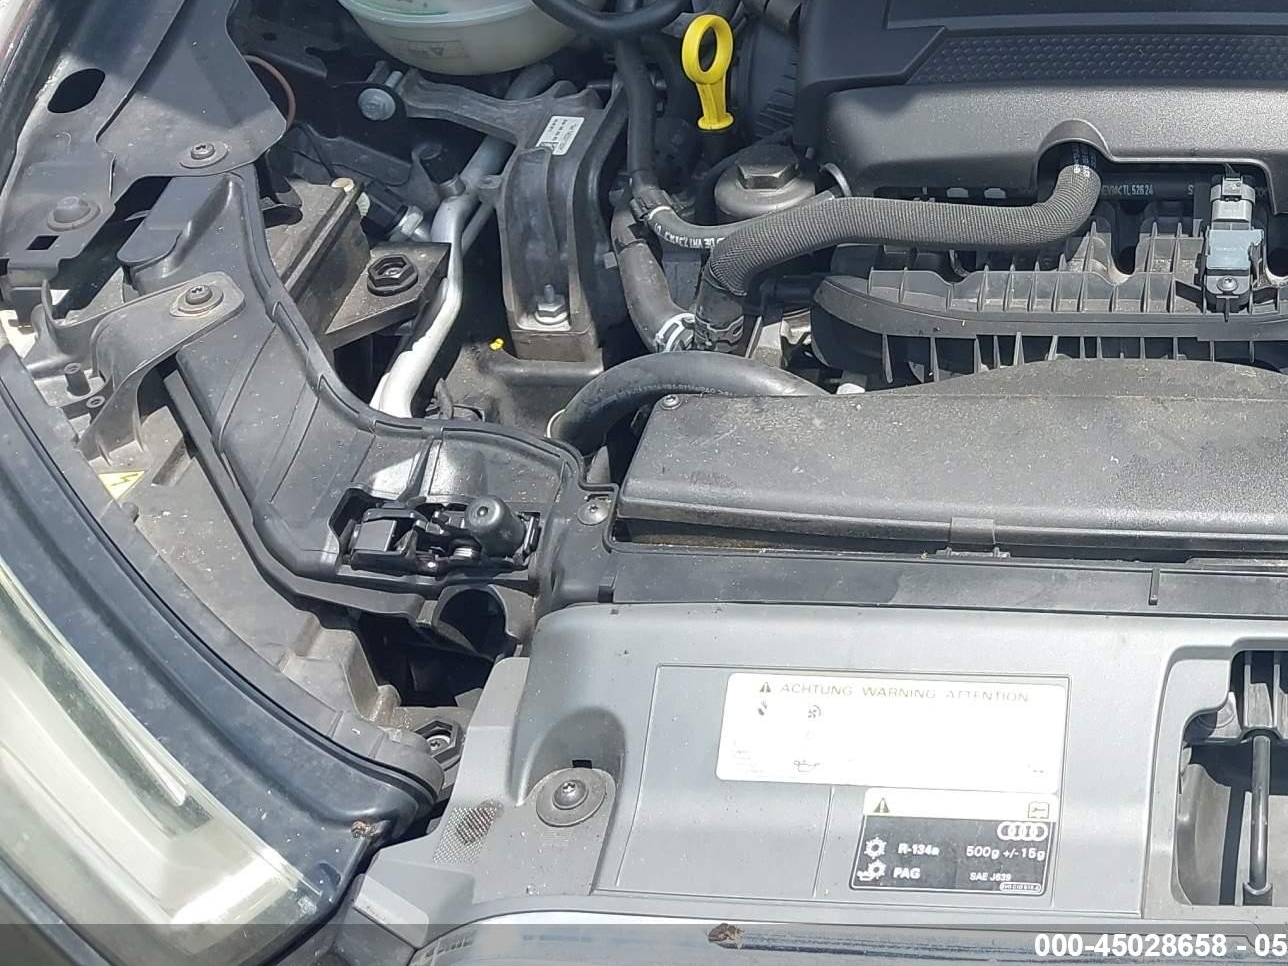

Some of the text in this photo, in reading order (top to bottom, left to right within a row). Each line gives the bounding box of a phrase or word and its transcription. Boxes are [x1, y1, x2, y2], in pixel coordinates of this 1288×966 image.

[779, 684, 1030, 704] ACHTUNG WARNING ATTENTION
[898, 843, 940, 857] R-134a
[966, 845, 1000, 860] 500g
[1022, 848, 1046, 862] 15g
[893, 866, 921, 880] PAG
[969, 872, 988, 882] SAE
